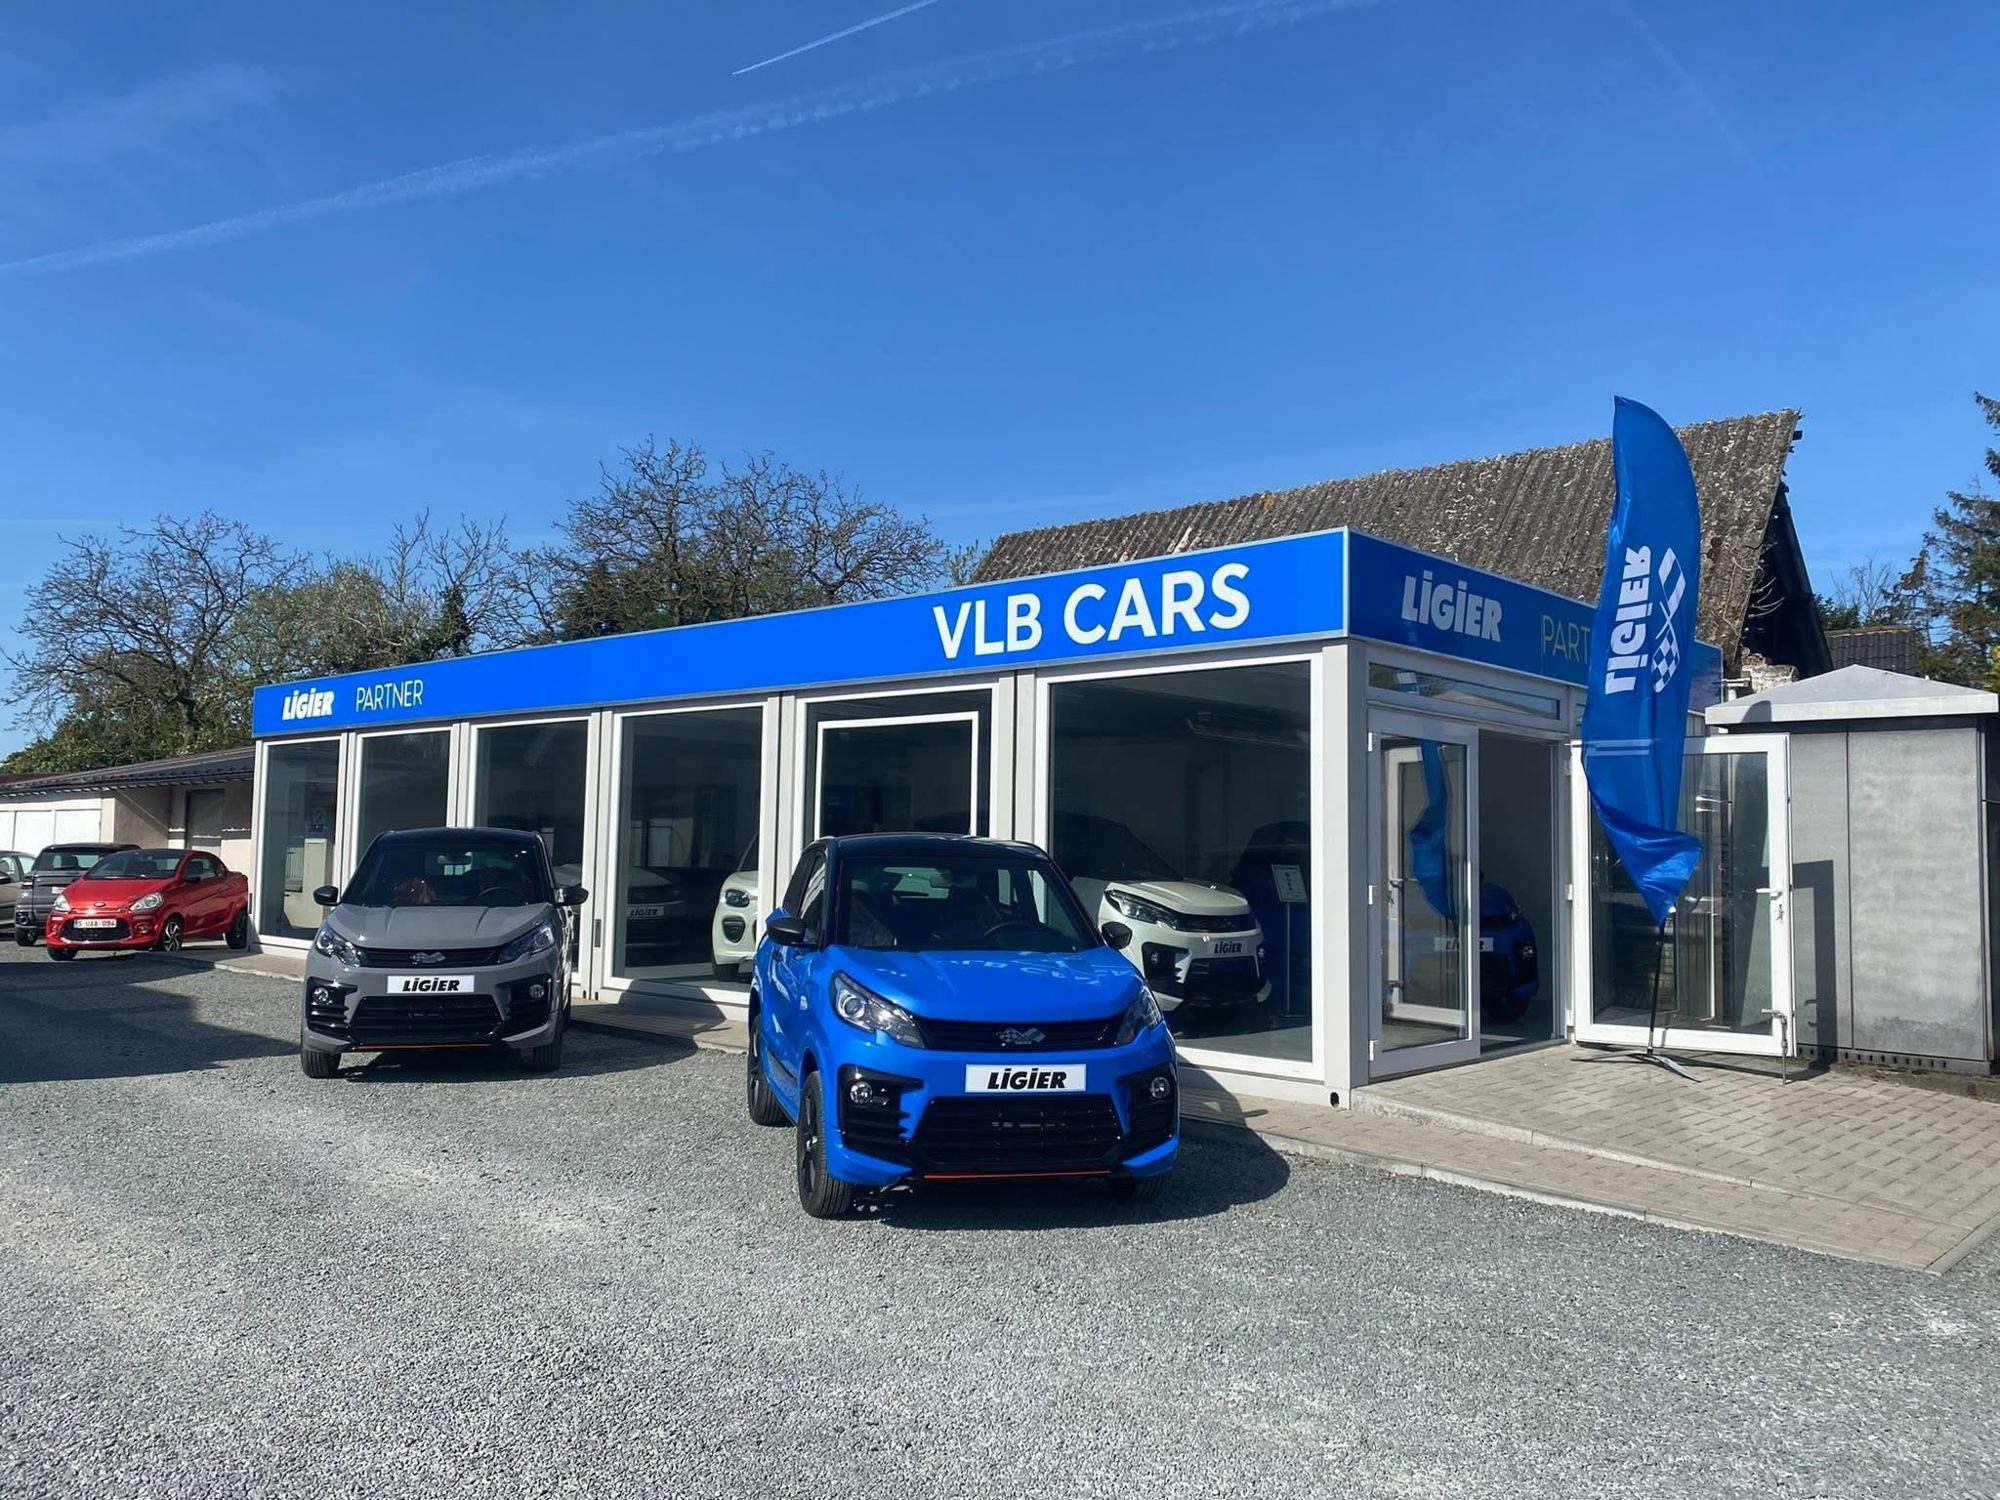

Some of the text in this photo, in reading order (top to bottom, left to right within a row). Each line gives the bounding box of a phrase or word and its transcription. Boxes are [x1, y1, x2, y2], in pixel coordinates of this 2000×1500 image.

[932, 562, 1250, 659] VLB CARS
[1542, 614, 1591, 665] PART
[355, 679, 424, 712] PARTNER
